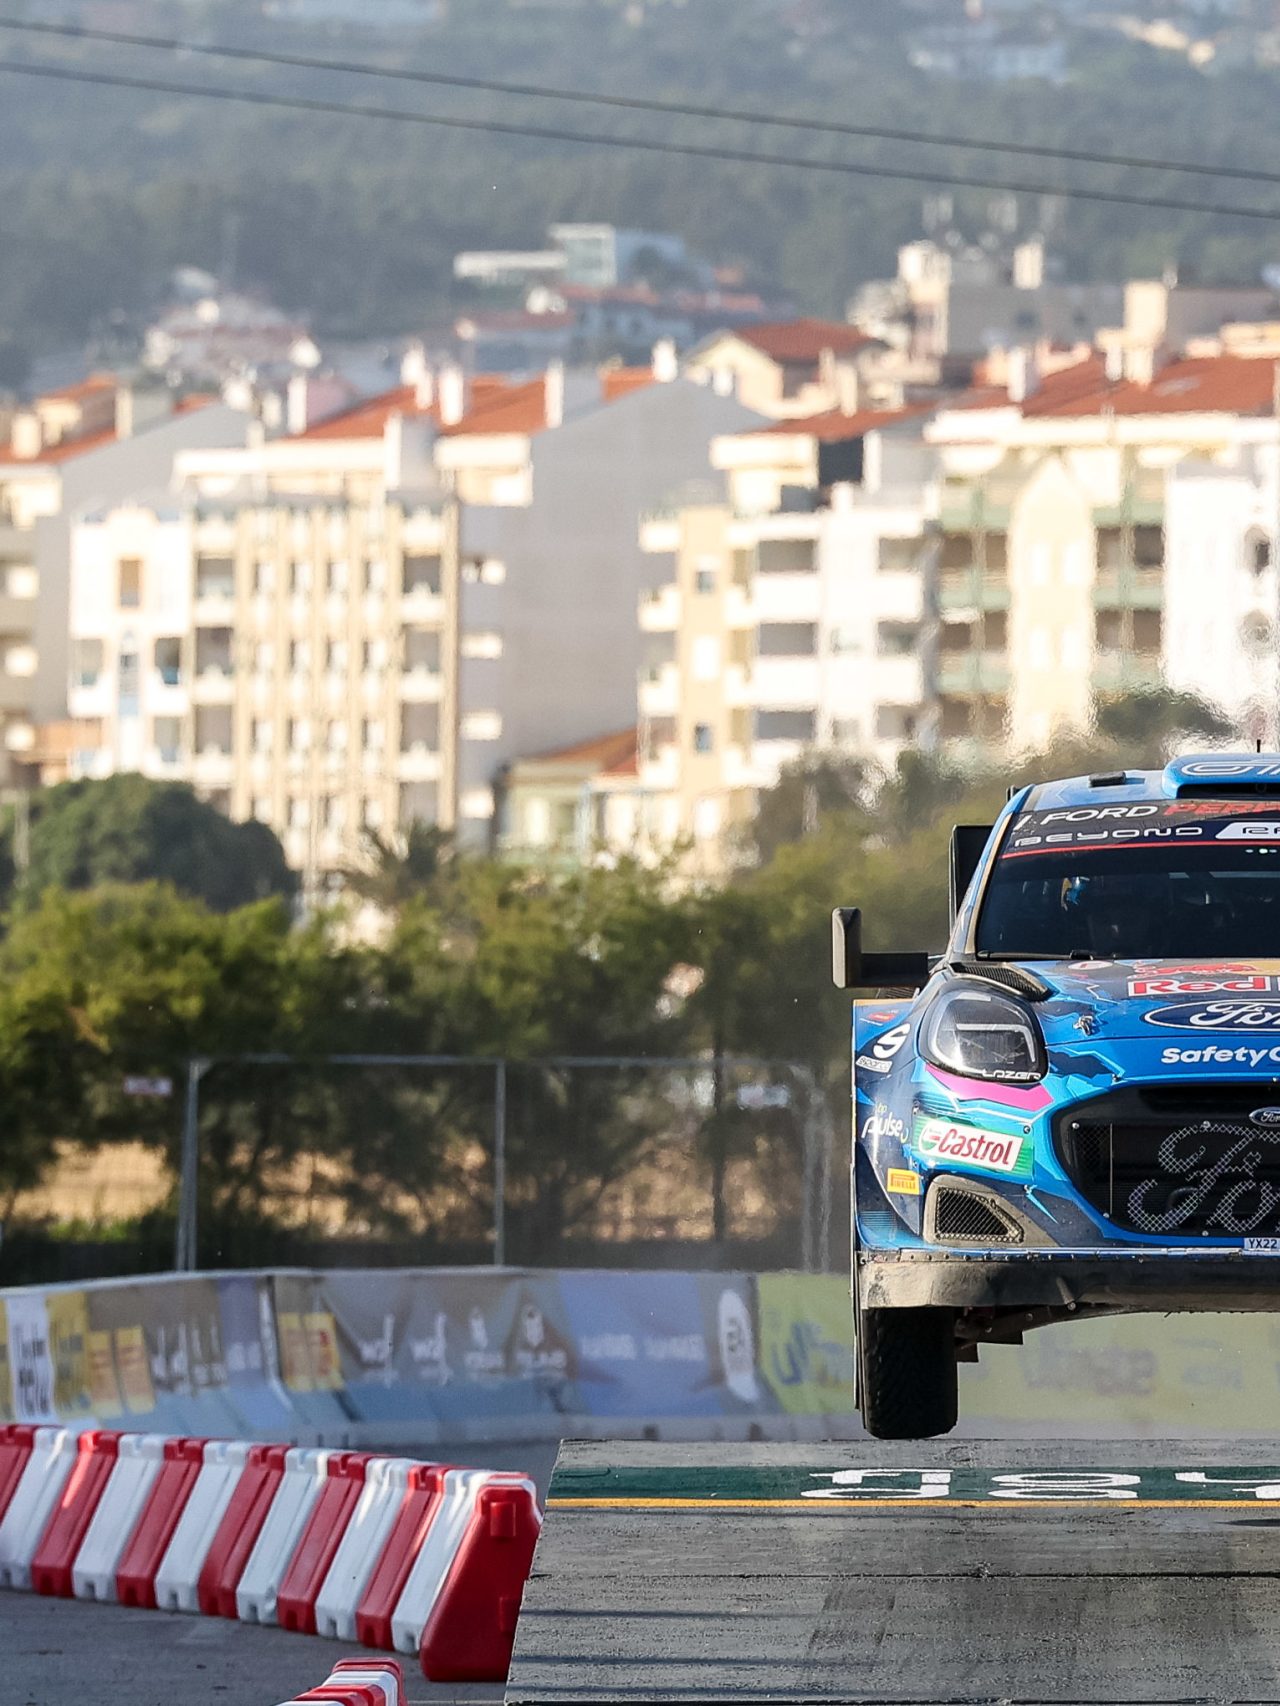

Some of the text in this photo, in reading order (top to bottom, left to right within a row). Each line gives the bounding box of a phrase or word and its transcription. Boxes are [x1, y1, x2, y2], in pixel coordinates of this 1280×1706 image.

[1040, 805, 1159, 825] FORD
[1014, 826, 1203, 848] BEYOND
[1128, 976, 1272, 996] Red
[982, 1068, 1041, 1080] LAZER
[862, 1112, 904, 1139] pulse
[938, 1128, 1014, 1165] Castrol
[1248, 1238, 1278, 1250] YX22
[798, 1484, 1139, 1499] da
